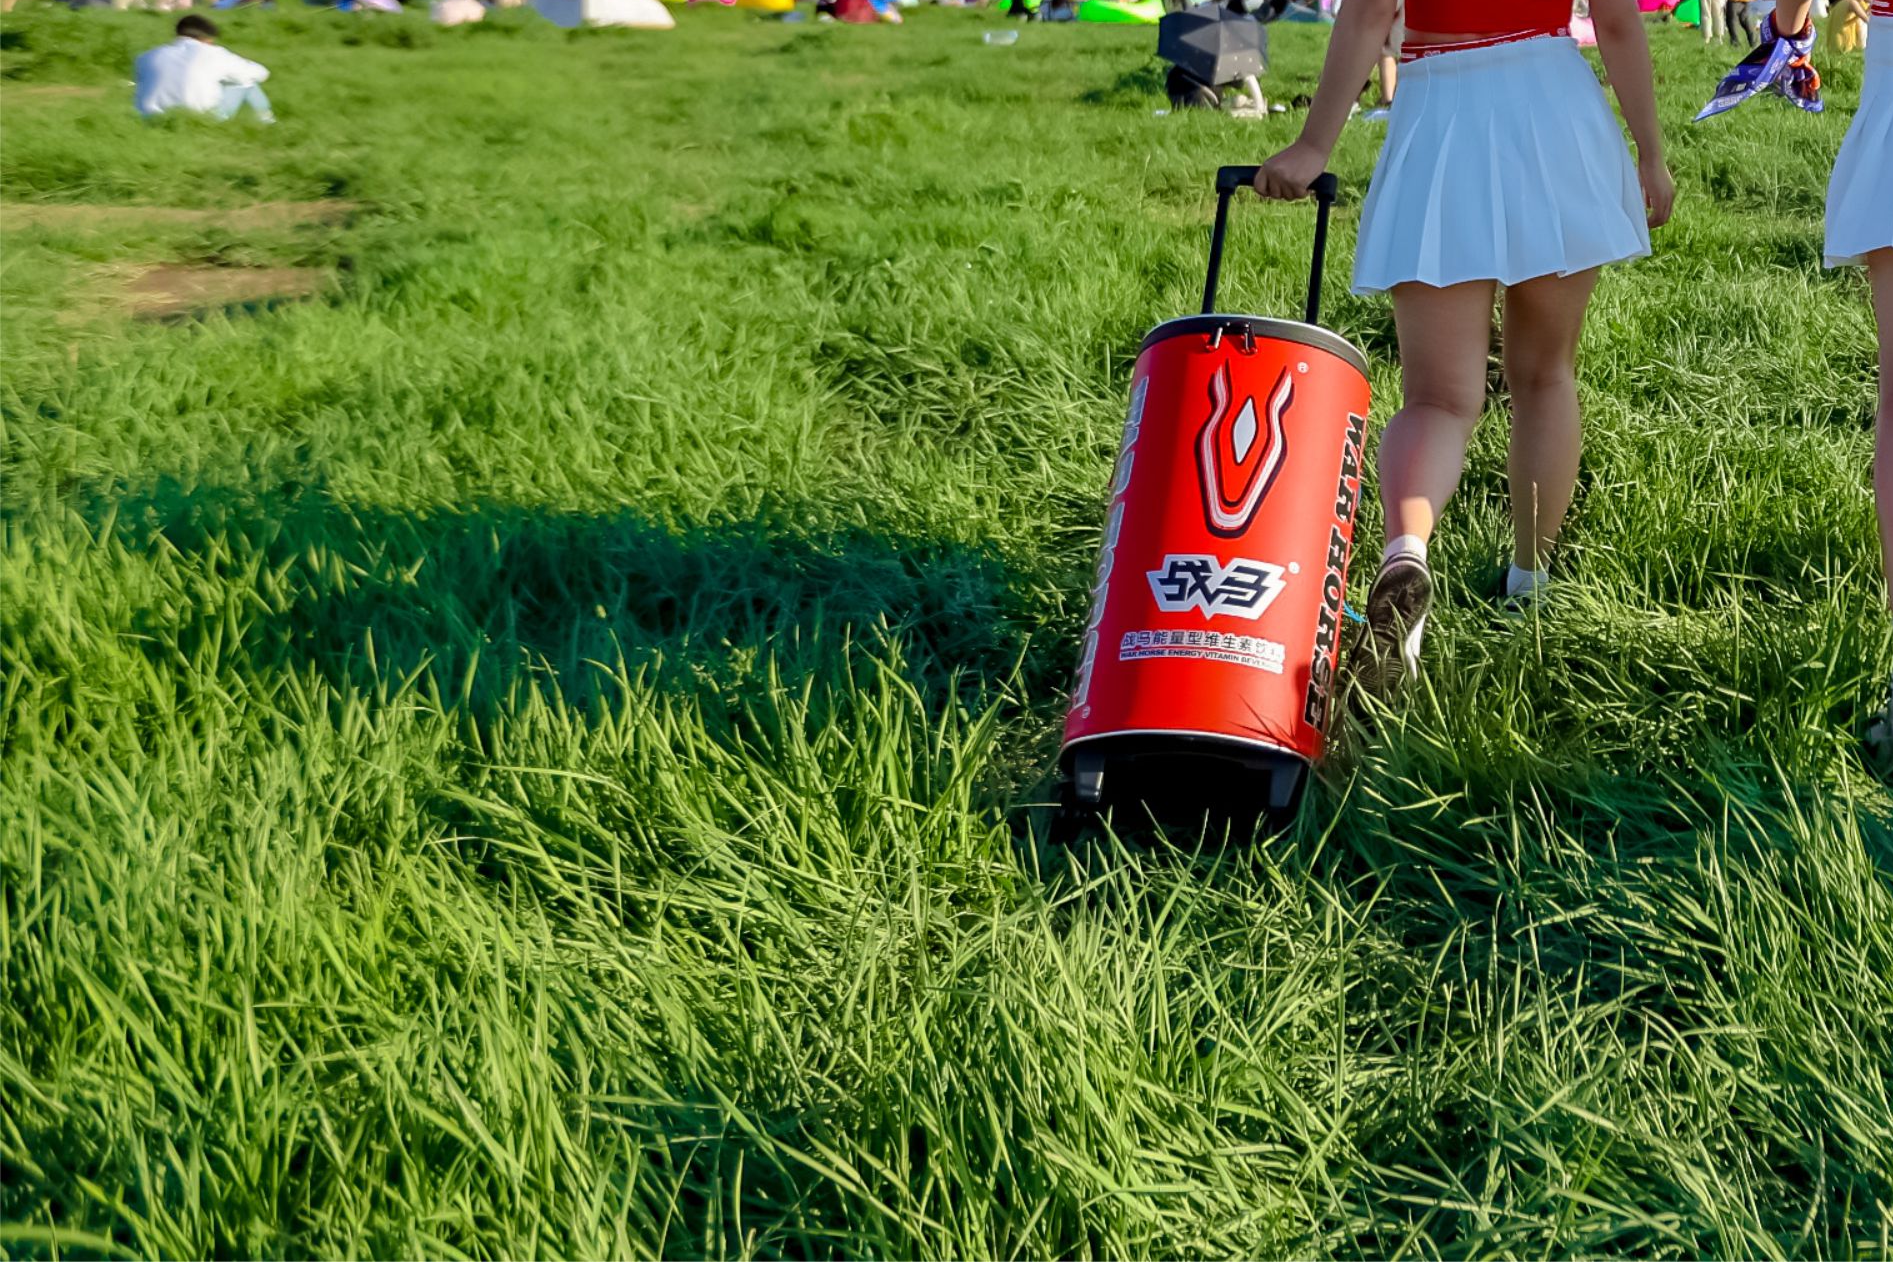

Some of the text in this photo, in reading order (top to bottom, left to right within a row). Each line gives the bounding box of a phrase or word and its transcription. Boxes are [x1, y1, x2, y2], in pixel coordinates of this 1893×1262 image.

[1153, 558, 1277, 612] 战马
[1122, 631, 1281, 658] 战马能量型维生素
[1303, 523, 1349, 736] HORSE
[1138, 649, 1166, 657] HORSE
[1167, 649, 1201, 658] ENERGY
[1205, 652, 1240, 662] VITAMIN
